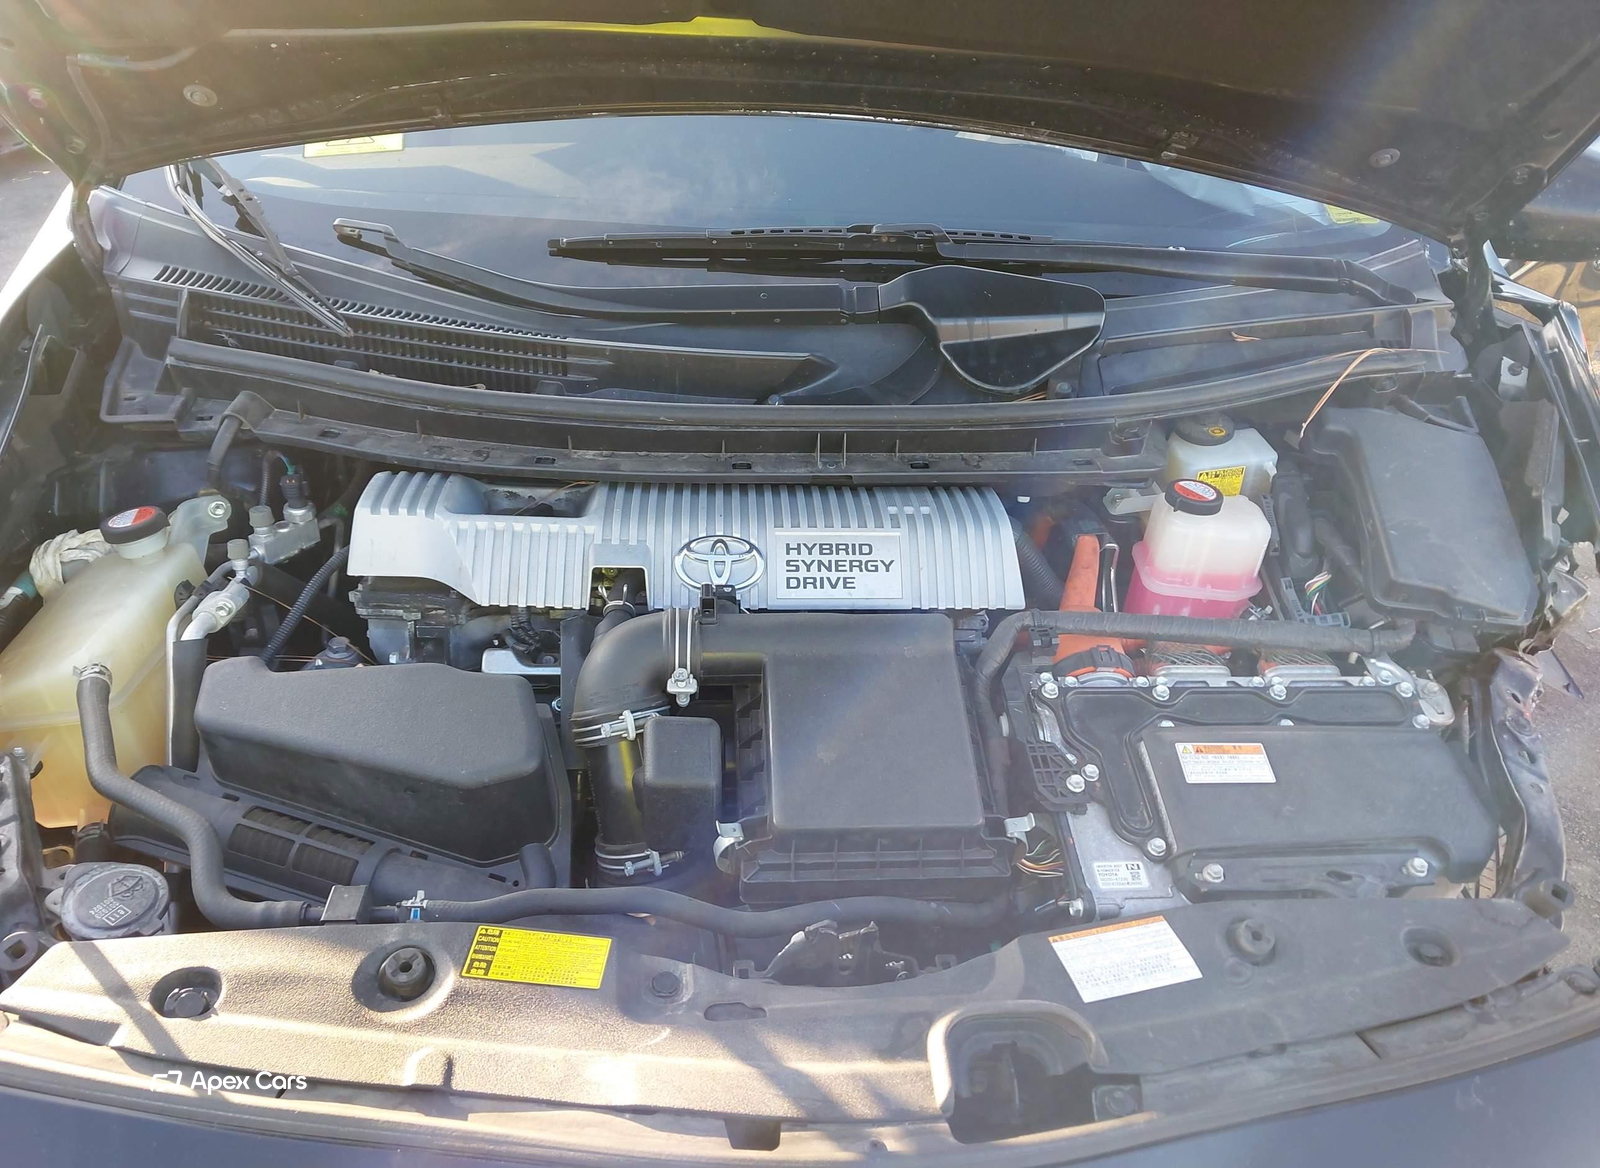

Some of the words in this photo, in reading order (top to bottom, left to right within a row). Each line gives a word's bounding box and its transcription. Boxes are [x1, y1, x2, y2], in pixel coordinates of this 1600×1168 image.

[785, 542, 873, 556] HYBRID
[785, 559, 895, 573] SYNERGY
[785, 576, 856, 590] DRIVE
[477, 935, 501, 943] CAUTION
